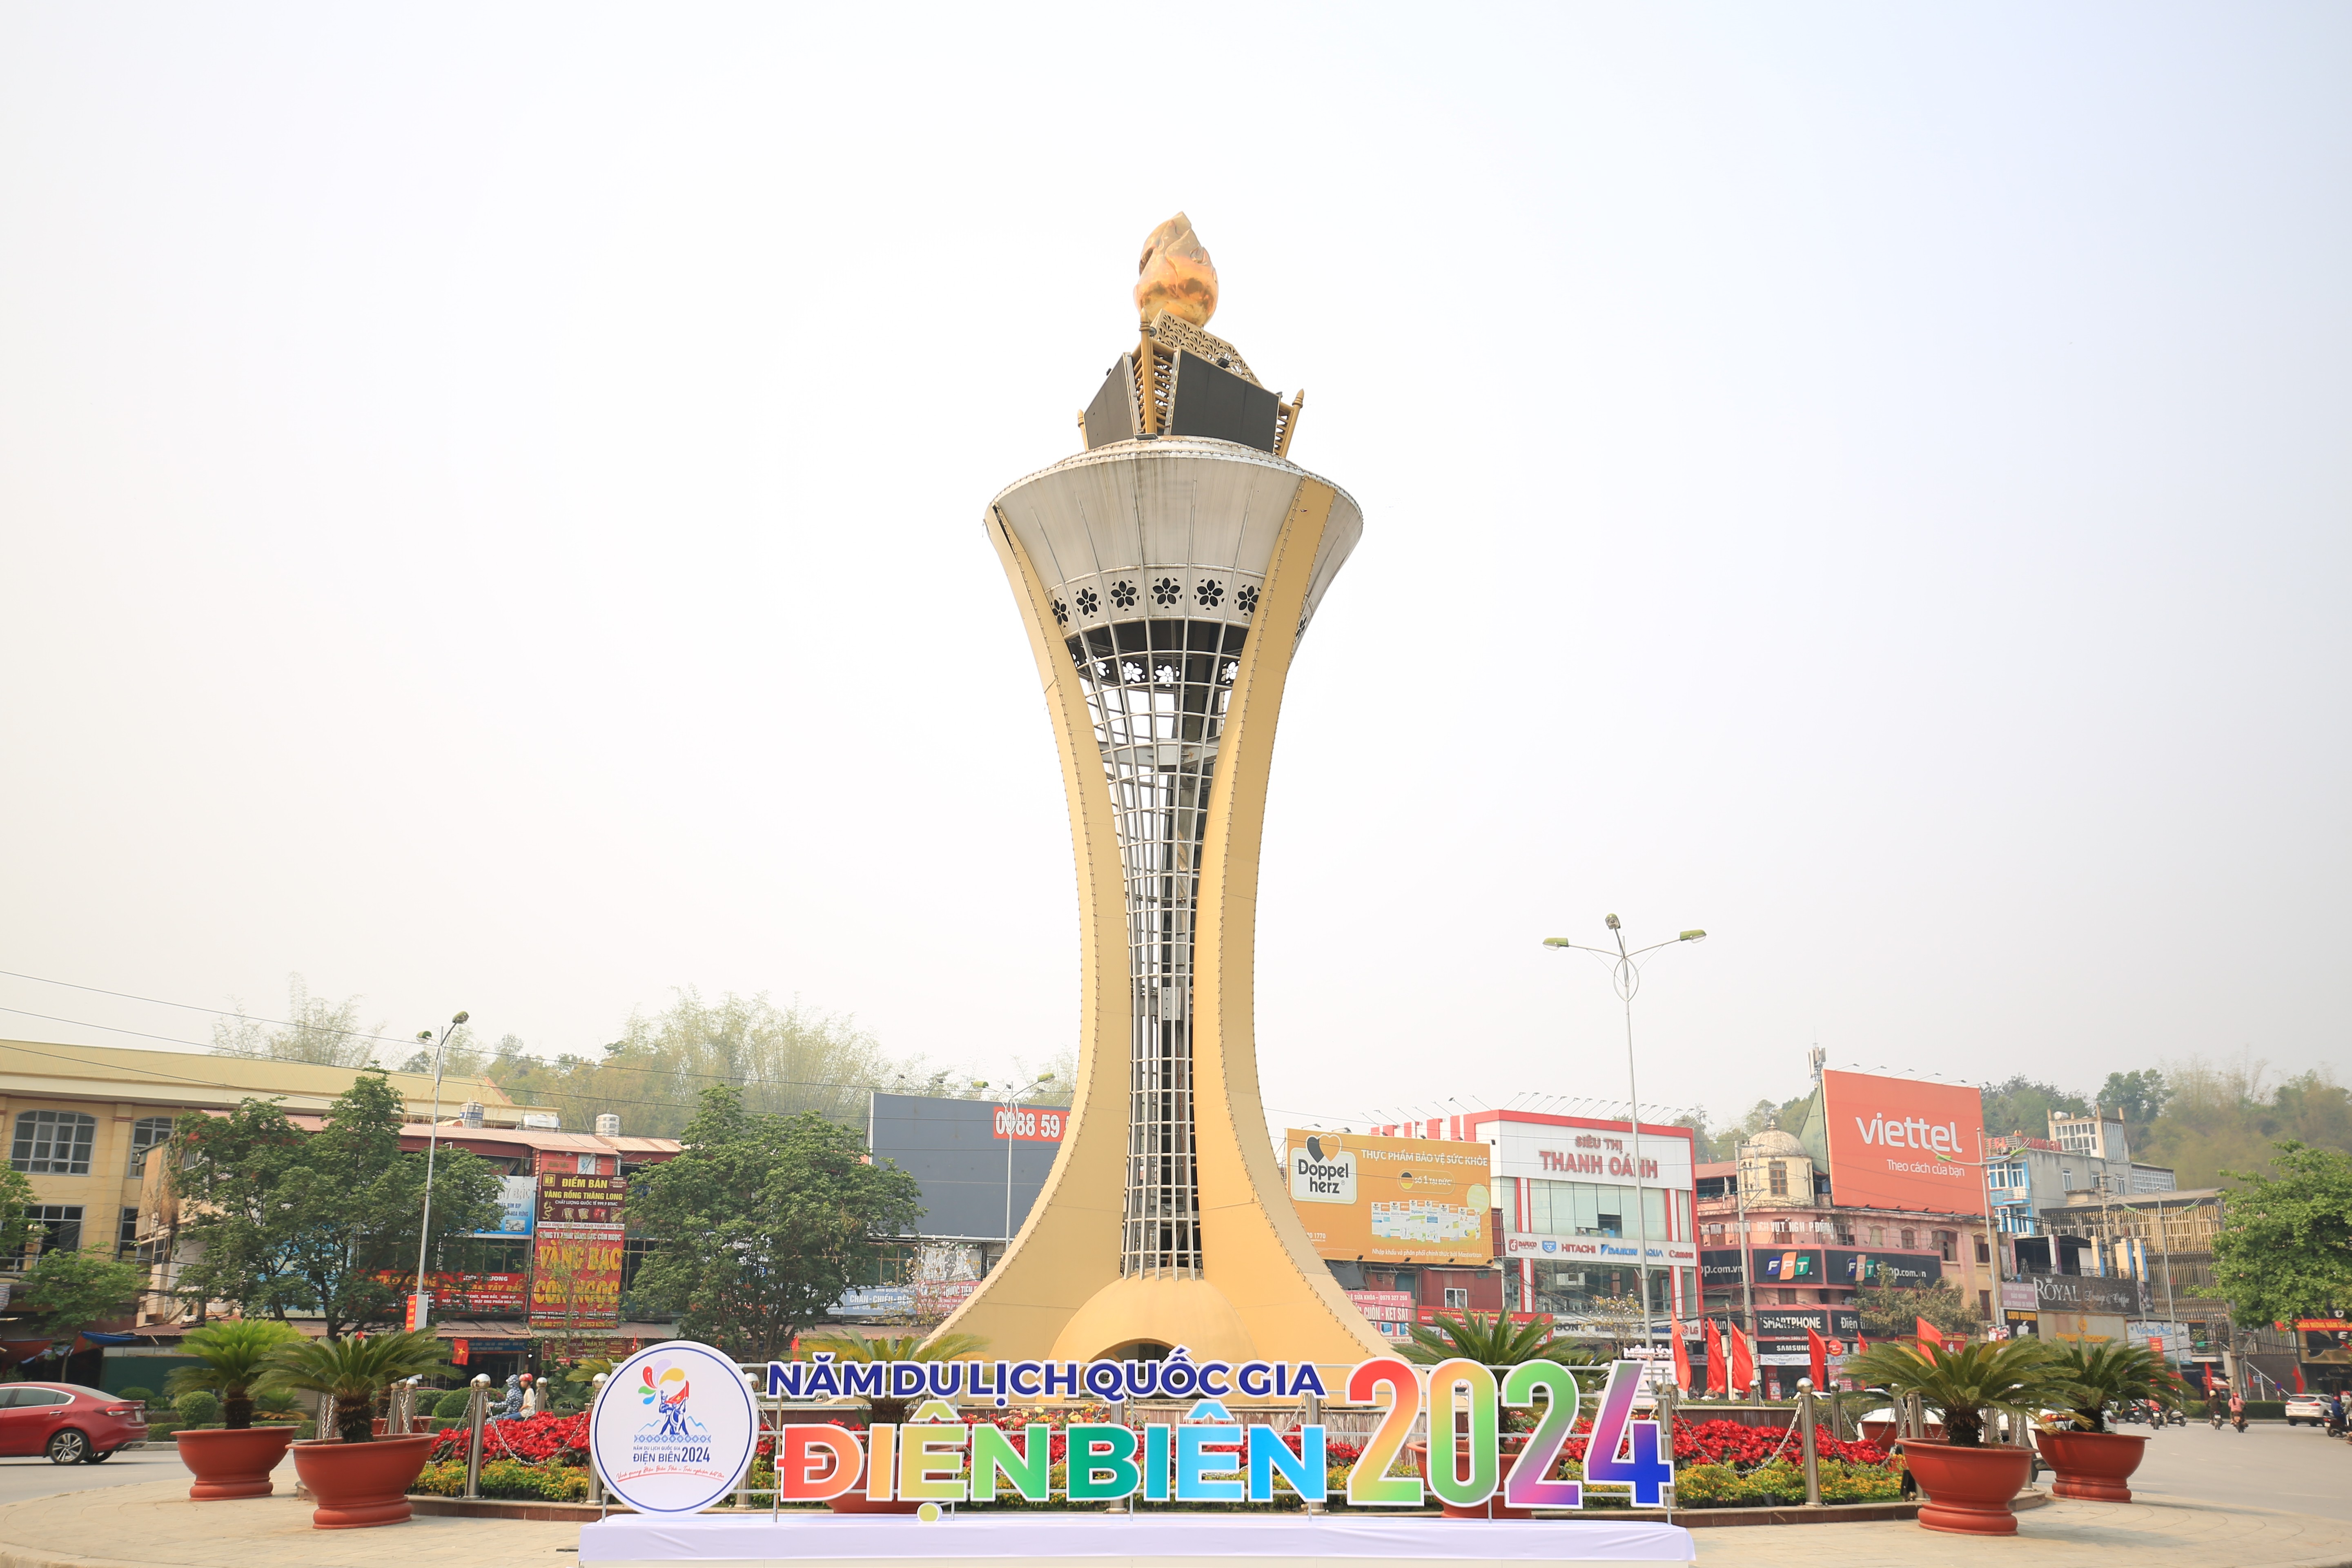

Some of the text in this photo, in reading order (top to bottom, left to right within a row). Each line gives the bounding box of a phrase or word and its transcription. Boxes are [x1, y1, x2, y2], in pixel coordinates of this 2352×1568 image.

[996, 1111, 1035, 1136] 0988
[1041, 1114, 1060, 1138] 59
[1855, 1113, 1962, 1153] viettel
[1576, 1135, 1623, 1154] SIÊU THỊ
[1361, 1149, 1488, 1166] THỰC PHẨM BẢO VỆ SỨC KHỎE
[1539, 1150, 1657, 1178] THANH OÁNH
[1298, 1159, 1348, 1180] Doppel
[1887, 1159, 1964, 1178] Theo cách của bạn
[562, 1176, 586, 1187] ĐIỂM
[588, 1176, 608, 1188] BÁN
[1310, 1177, 1340, 1194] herz
[1414, 1176, 1422, 1184] SỐ
[1424, 1176, 1428, 1184] 1
[544, 1189, 562, 1198] VÀNG
[564, 1190, 581, 1199] RỒNG
[584, 1190, 604, 1200] THĂNG
[539, 1240, 585, 1270] VÀNG
[1561, 1243, 1596, 1253] HITACHI
[1608, 1247, 1638, 1255] DAIKIN
[1669, 1250, 1693, 1258] Canon
[1768, 1260, 1808, 1272] FPT
[1849, 1262, 1874, 1275] FPT
[2034, 1277, 2081, 1310] ROYAL
[1397, 1303, 1408, 1321] SẮT
[1763, 1317, 1821, 1329] SMARTPHONE
[1841, 1316, 1857, 1332] Điện
[768, 1345, 1329, 1408] NĂM DU LỊCH QUỐC GIA
[775, 1357, 1675, 1522] ĐIỆN BIÊN 2024
[633, 1446, 710, 1465] ĐIỆN BIÊN 2024
